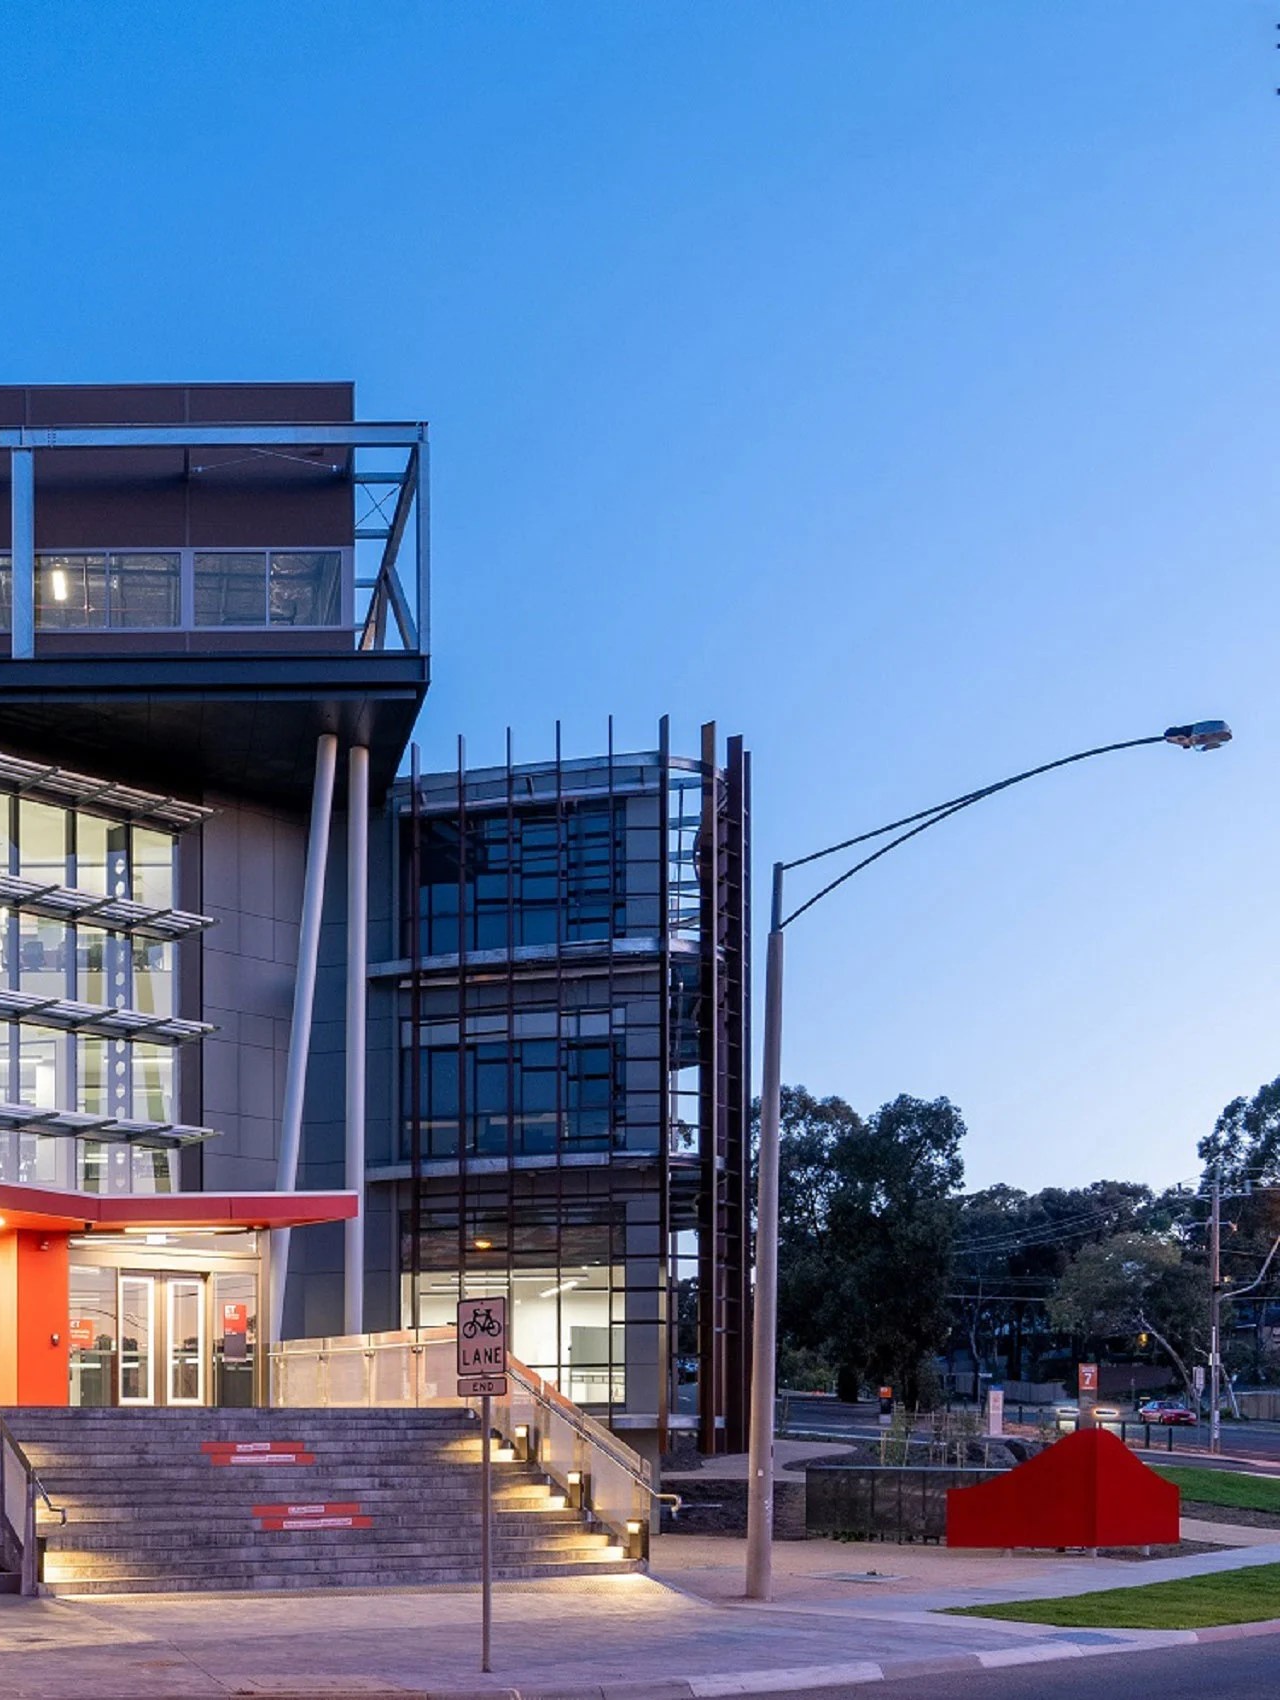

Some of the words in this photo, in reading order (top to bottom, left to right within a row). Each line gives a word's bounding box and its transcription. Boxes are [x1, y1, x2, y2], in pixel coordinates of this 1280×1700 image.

[463, 1347, 501, 1365] LANE
[1084, 1373, 1092, 1385] 7
[472, 1382, 494, 1392] END
